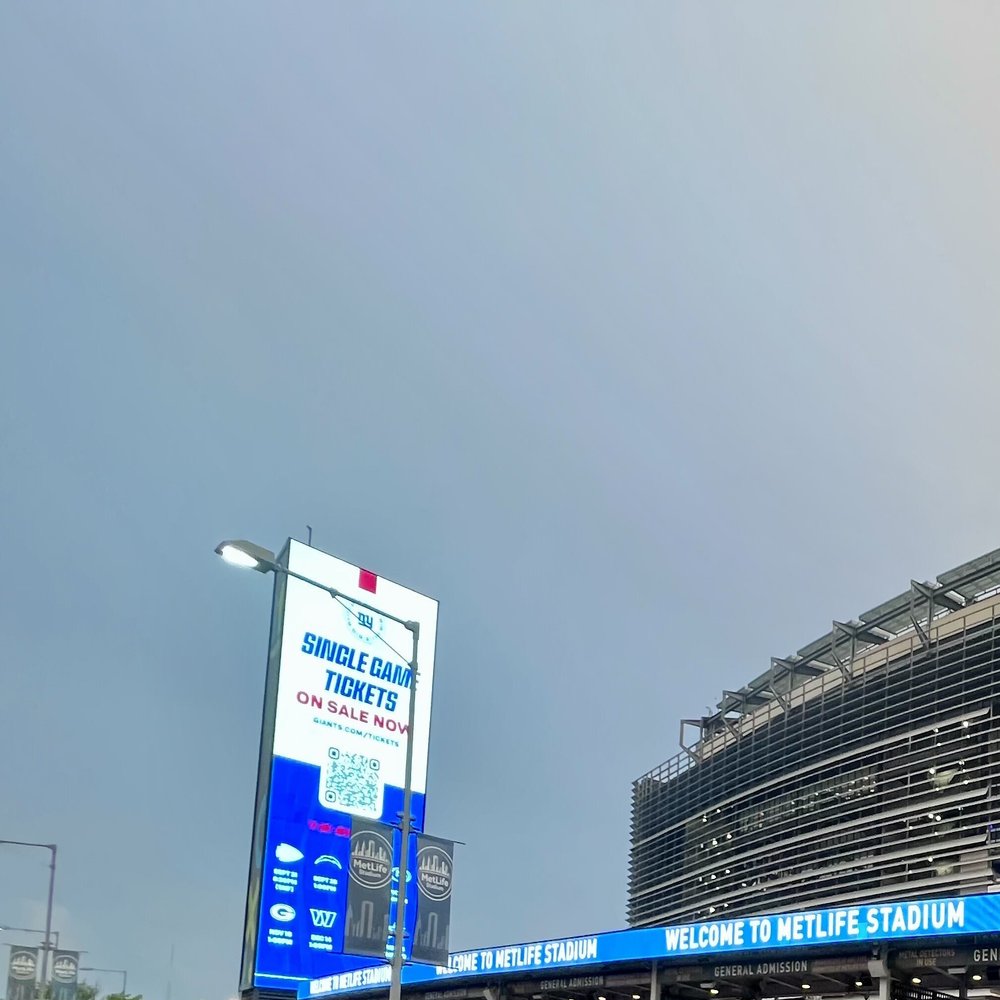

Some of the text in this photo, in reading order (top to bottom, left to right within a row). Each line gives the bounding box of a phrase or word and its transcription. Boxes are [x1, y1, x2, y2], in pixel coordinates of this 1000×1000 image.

[301, 631, 418, 690] SINGLE GAM
[324, 668, 399, 712] TICKETS
[296, 691, 323, 710] ON
[327, 701, 369, 723] SALE
[313, 717, 399, 748] GIANTS.COM/TICKETS
[353, 859, 388, 874] MetLife
[421, 873, 448, 887] MetLife
[665, 901, 965, 952] WELCOME TO METLIFE STADIUM
[481, 951, 493, 970] TO
[495, 945, 542, 969] METLIFE
[544, 938, 598, 964] STADIUM
[714, 965, 753, 977] GENERAL
[756, 960, 808, 975] ADMISSION
[540, 978, 567, 990] GENERAL
[568, 975, 604, 988] ADMISSION
